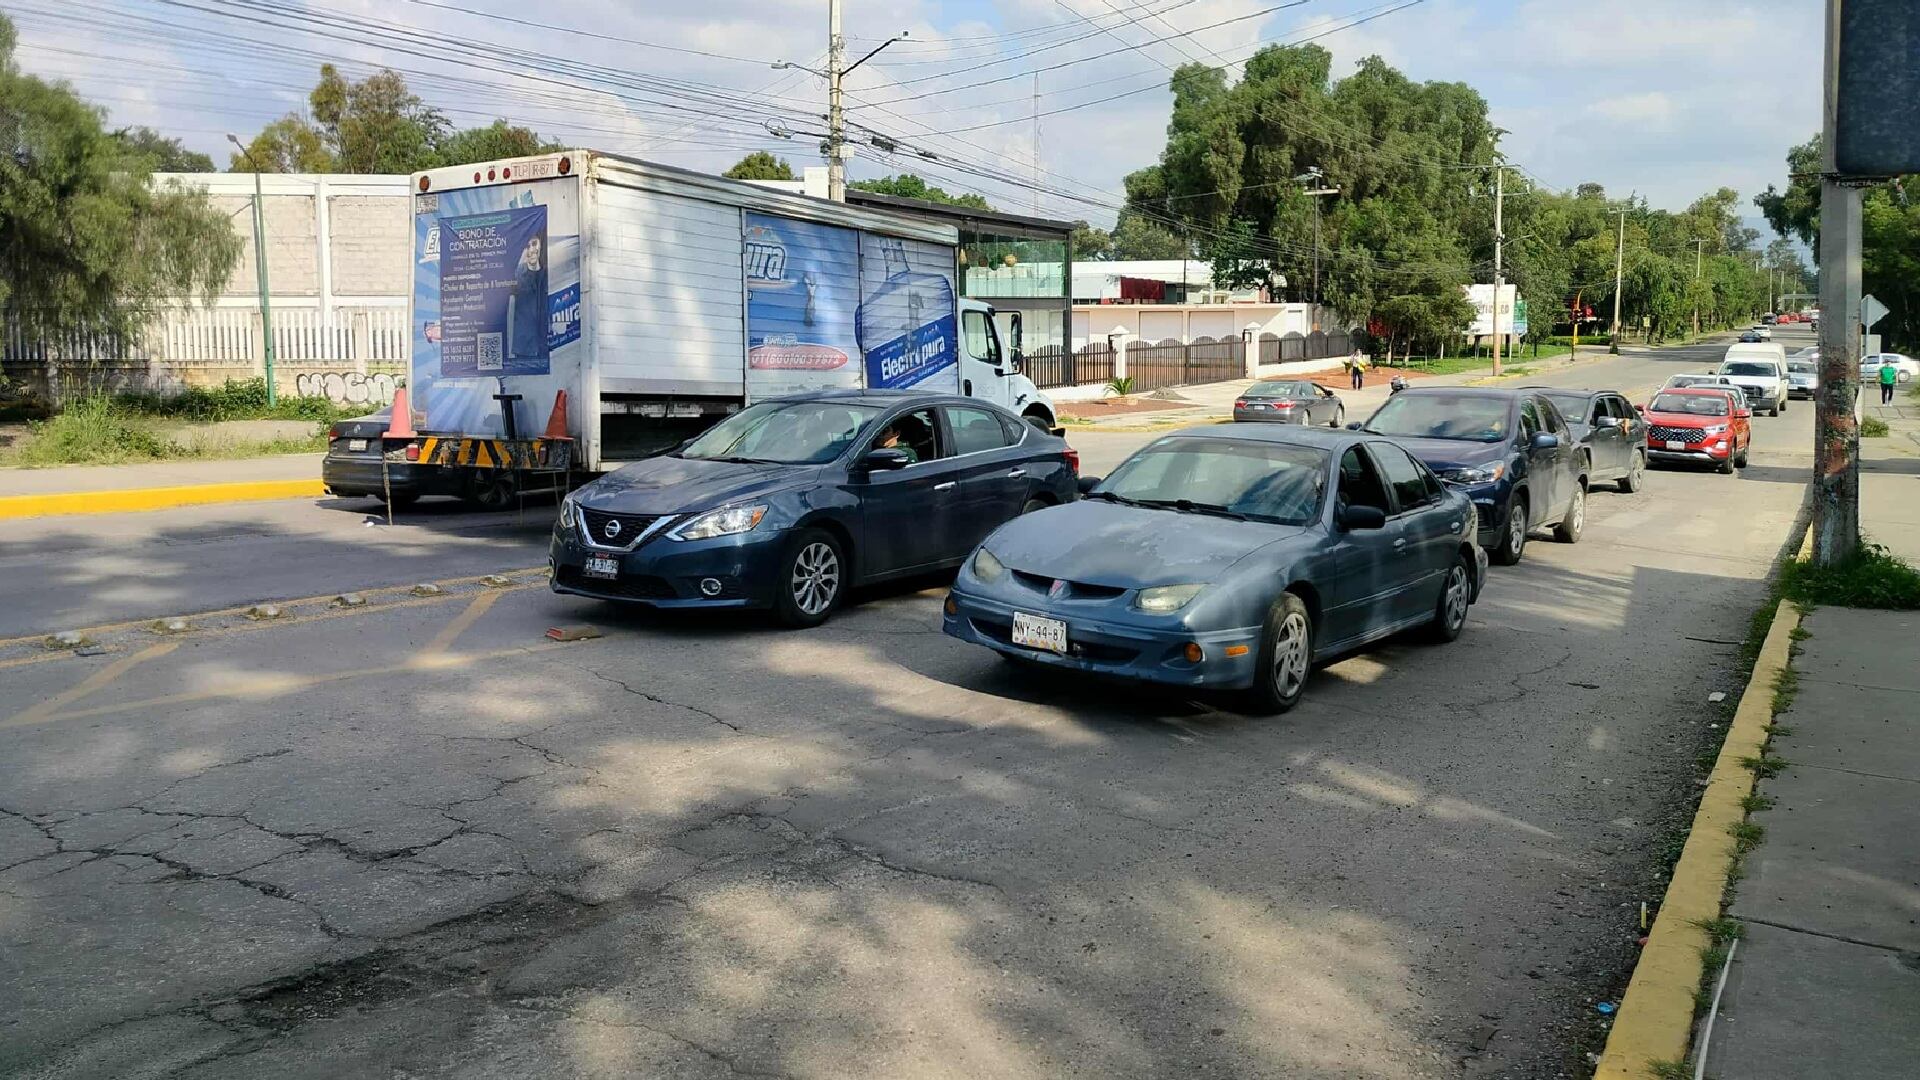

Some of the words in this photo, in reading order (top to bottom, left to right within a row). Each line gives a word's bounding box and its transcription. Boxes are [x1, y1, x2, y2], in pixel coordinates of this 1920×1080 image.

[513, 165, 528, 177] TLP
[459, 228, 483, 240] BONO
[485, 226, 497, 237] DE
[1014, 620, 1064, 642] NNY-44-87
